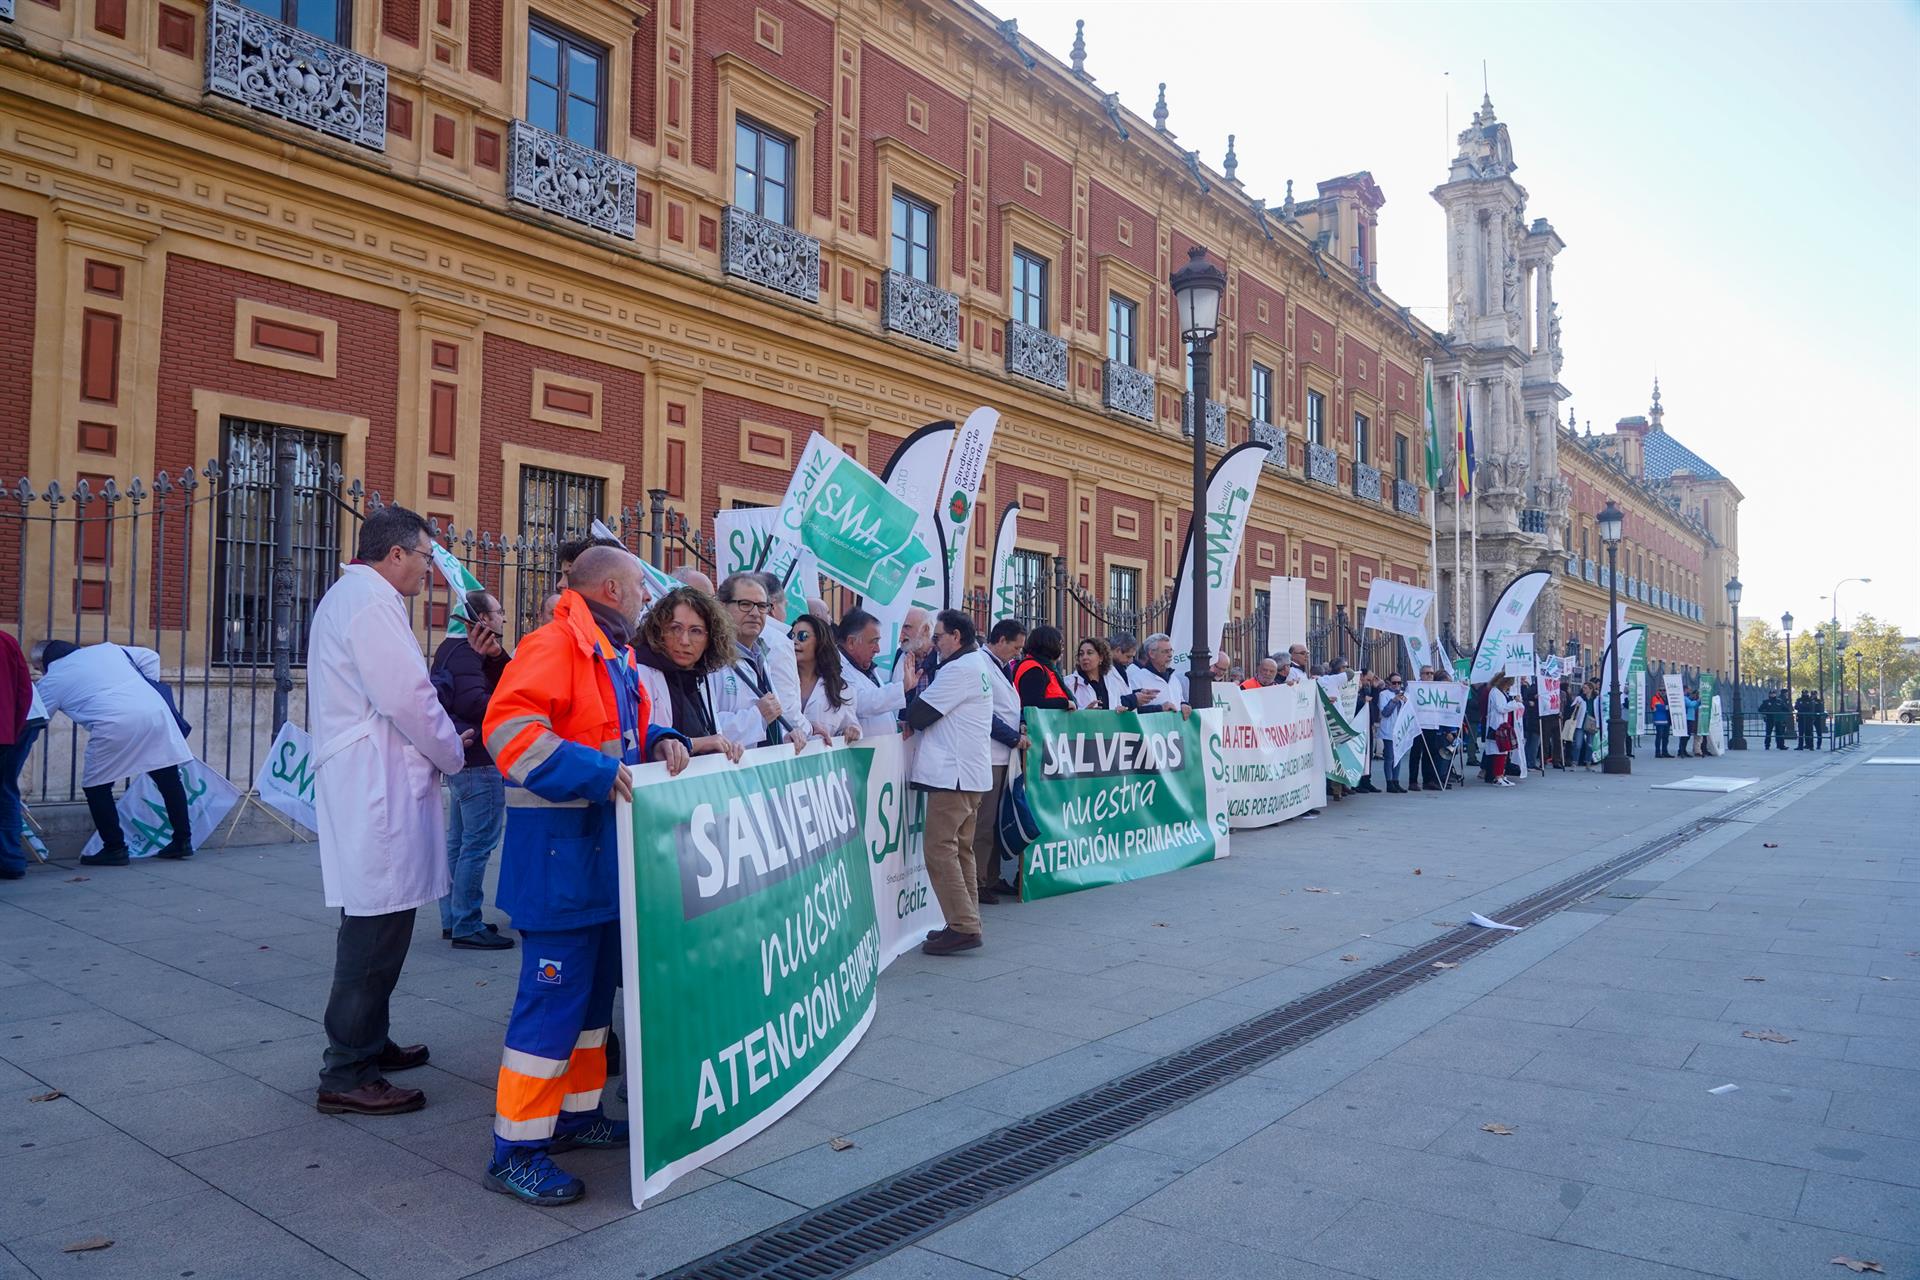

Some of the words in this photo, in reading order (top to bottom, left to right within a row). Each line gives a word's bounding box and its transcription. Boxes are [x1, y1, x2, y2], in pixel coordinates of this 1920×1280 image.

[955, 431, 973, 486] Sindicato
[962, 445, 976, 490] Médico
[972, 428, 980, 444] de
[968, 442, 984, 492] Granada
[783, 448, 832, 531] Cádiz
[815, 483, 889, 550] SMA
[1217, 480, 1233, 513] Sevilla
[1475, 629, 1503, 671] SMA
[1506, 643, 1531, 659] SMA
[1416, 687, 1460, 709] SMA
[271, 741, 316, 803] SM
[1043, 730, 1183, 776] SALVEMOS
[1062, 775, 1157, 830] nuestra
[690, 767, 856, 898] SALVEMOS
[1029, 827, 1120, 876] ATENCIÓN
[1124, 819, 1206, 857] PRIMARIA
[760, 858, 852, 996] nuestra
[897, 880, 927, 920] Cádiz
[690, 971, 842, 1131] ATENCIÓN
